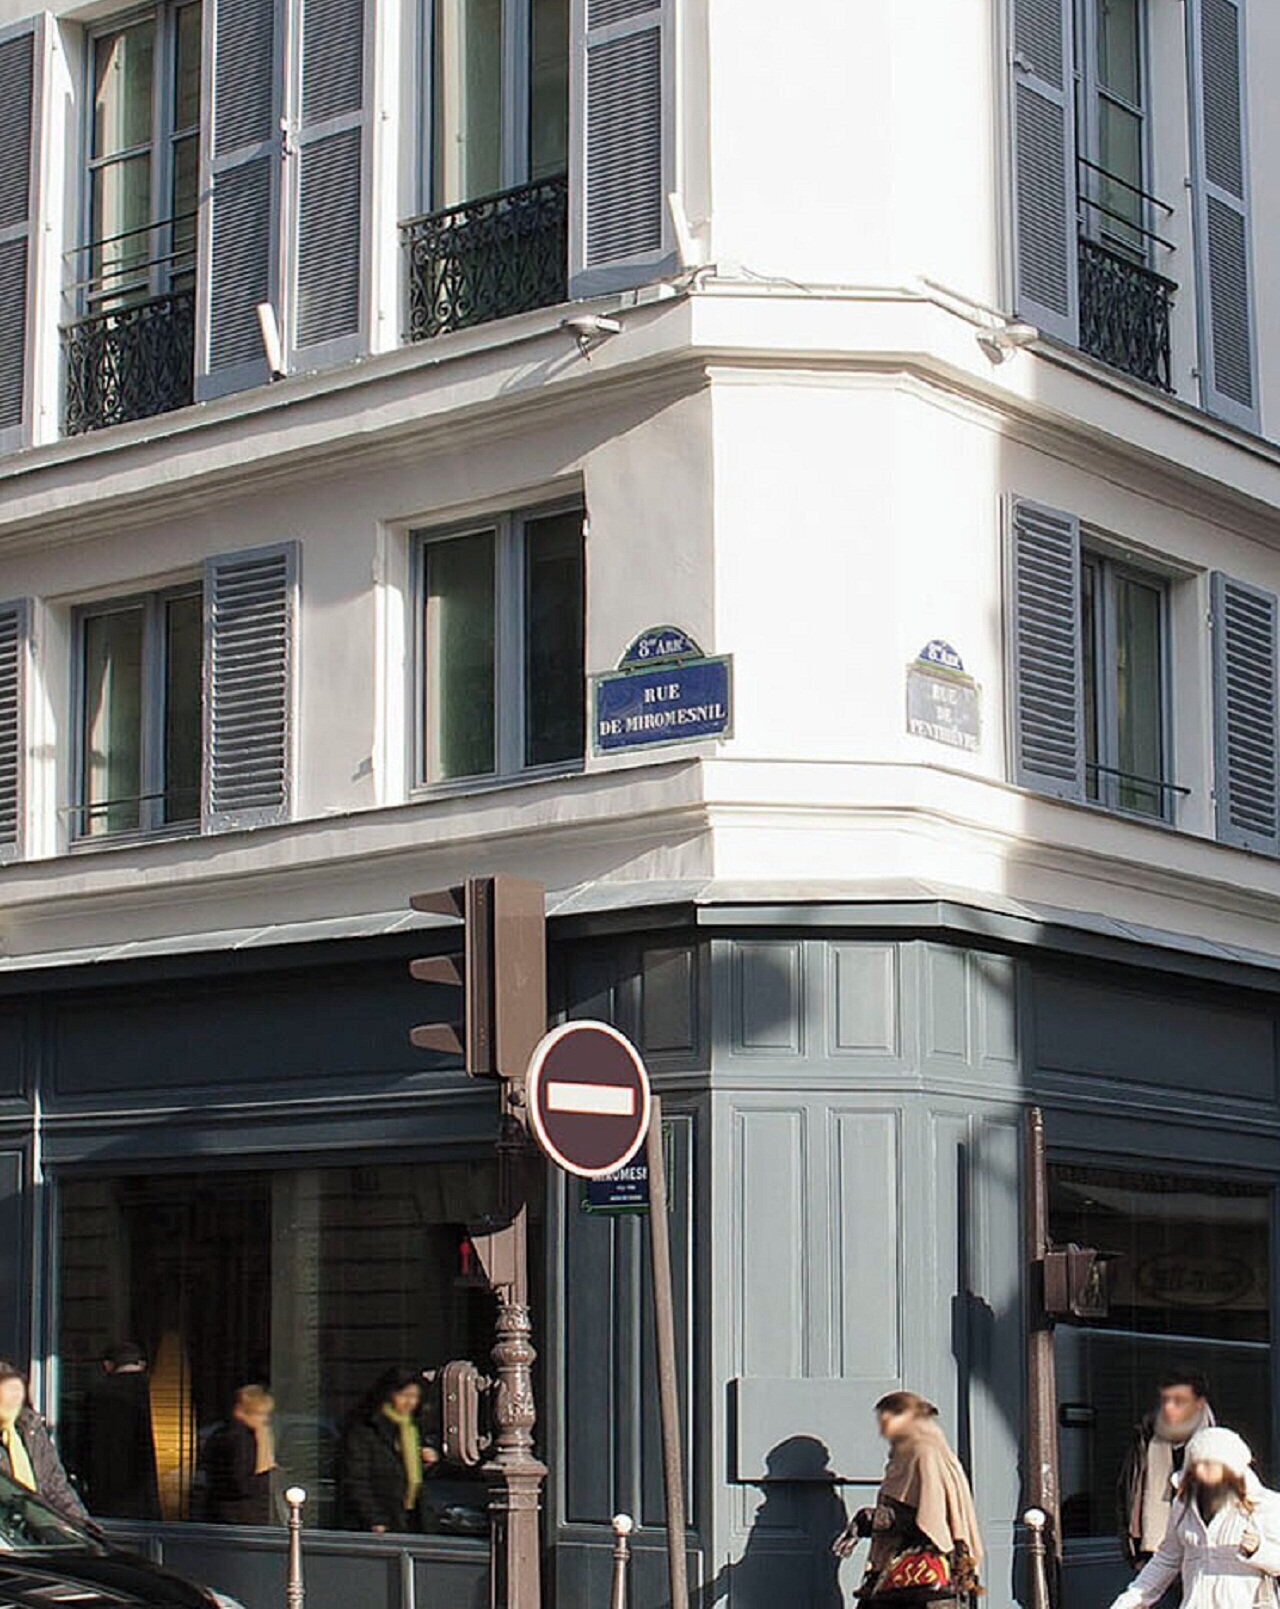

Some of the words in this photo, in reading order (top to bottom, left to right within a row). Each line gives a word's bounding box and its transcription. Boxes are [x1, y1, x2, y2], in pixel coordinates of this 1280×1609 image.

[644, 683, 681, 703] RUE
[599, 719, 621, 736] DE
[624, 703, 726, 733] MIROMESNIL
